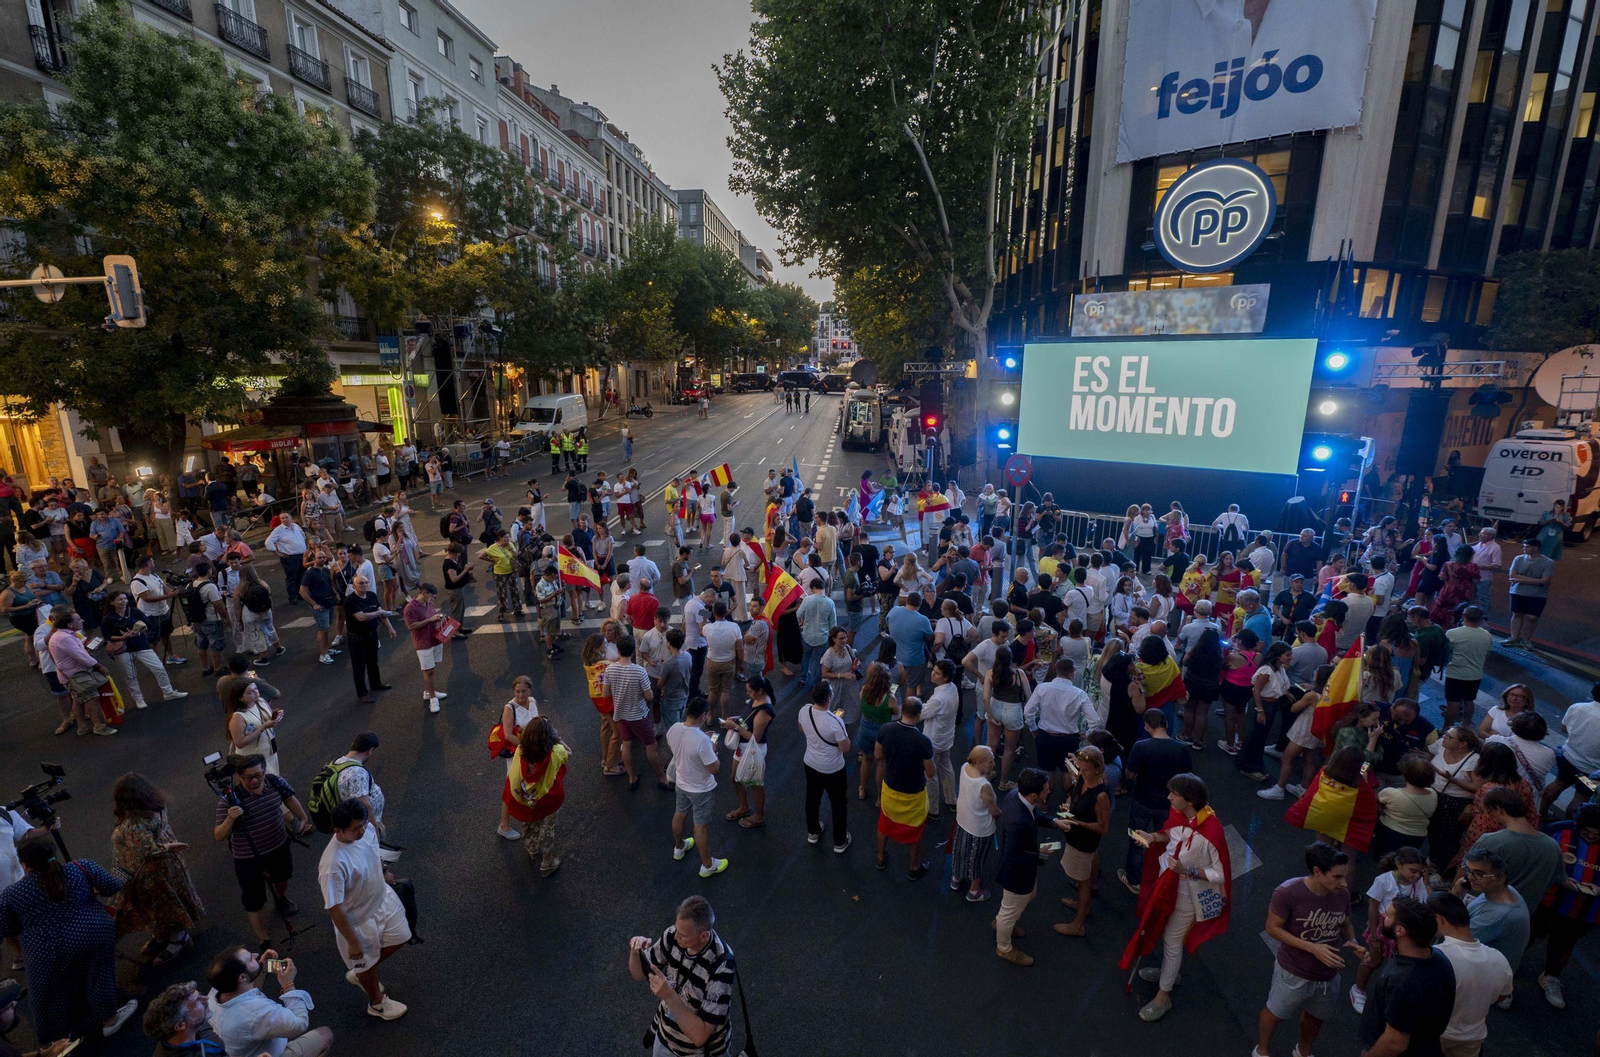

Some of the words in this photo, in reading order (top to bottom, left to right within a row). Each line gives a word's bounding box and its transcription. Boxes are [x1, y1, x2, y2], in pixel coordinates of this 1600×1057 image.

[1156, 49, 1324, 119] feijóo
[1073, 355, 1111, 393] ES
[1118, 355, 1156, 394] EL
[1069, 394, 1237, 438] MOMENTO
[1440, 415, 1494, 448] OMENTO
[1500, 448, 1563, 461] overon
[1510, 465, 1545, 476] HD
[1197, 888, 1213, 899] POR
[1199, 893, 1221, 906] TODO
[1202, 904, 1212, 913] LO
